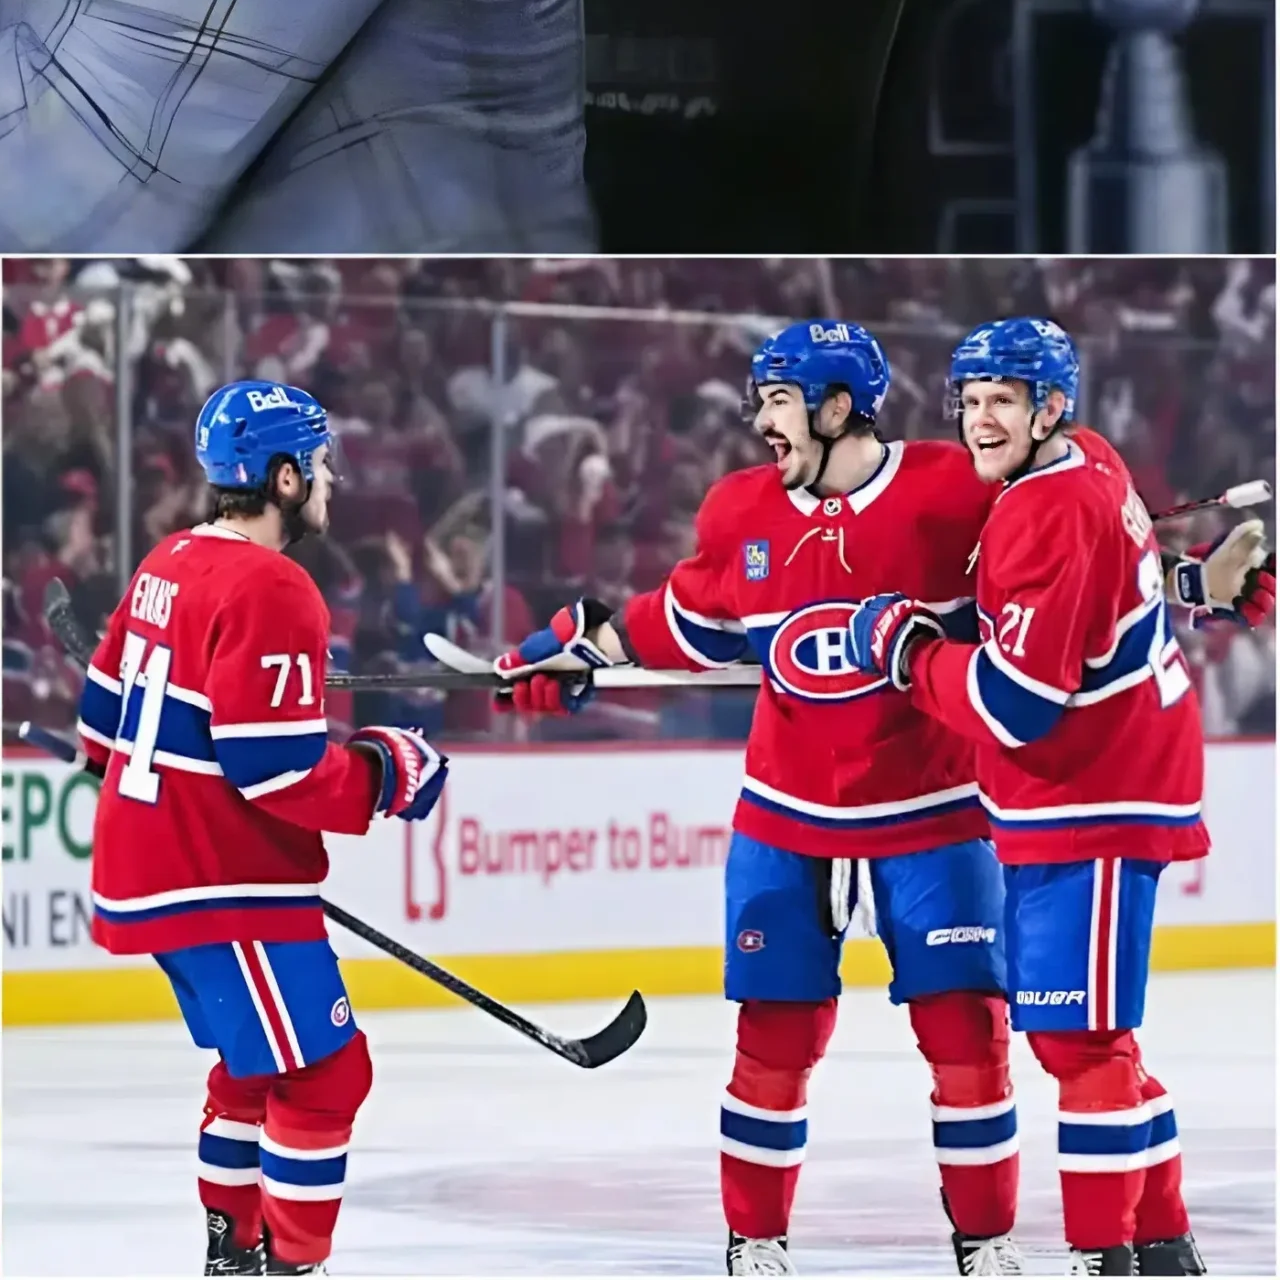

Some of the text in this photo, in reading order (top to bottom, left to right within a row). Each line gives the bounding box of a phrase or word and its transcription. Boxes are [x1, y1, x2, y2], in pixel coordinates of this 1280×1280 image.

[998, 602, 1037, 658] 21
[261, 652, 315, 708] 71
[115, 630, 172, 806] 71
[458, 817, 598, 888] Bumper
[607, 819, 642, 870] to
